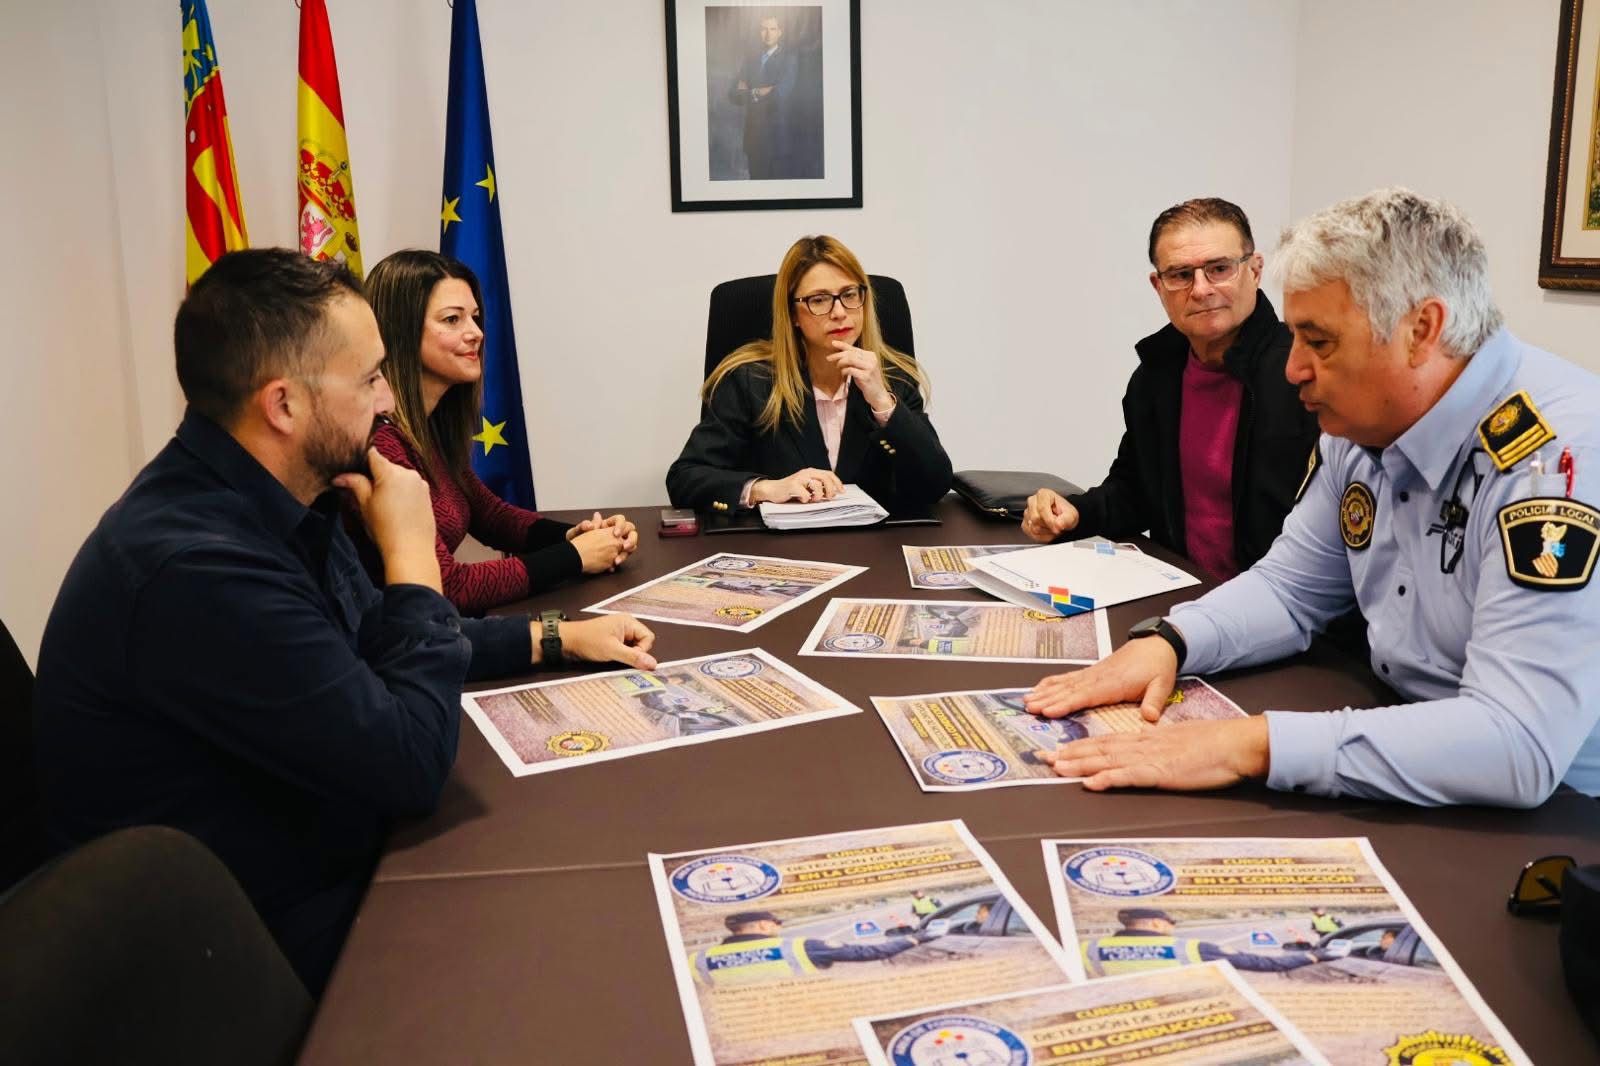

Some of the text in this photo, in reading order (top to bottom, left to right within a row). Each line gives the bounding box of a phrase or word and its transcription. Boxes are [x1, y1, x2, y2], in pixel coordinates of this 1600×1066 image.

[1560, 506, 1595, 525] LOCAL
[1275, 857, 1295, 865] DE
[797, 871, 820, 881] EN
[822, 868, 843, 879] LA
[1193, 876, 1217, 885] EN
[1219, 877, 1238, 885] LA
[1076, 999, 1158, 1020] CURSO DE
[1133, 1014, 1151, 1025] DE
[1158, 1001, 1231, 1019] DROGAS
[1052, 1041, 1080, 1056] EN
[1080, 1037, 1106, 1051] LA
